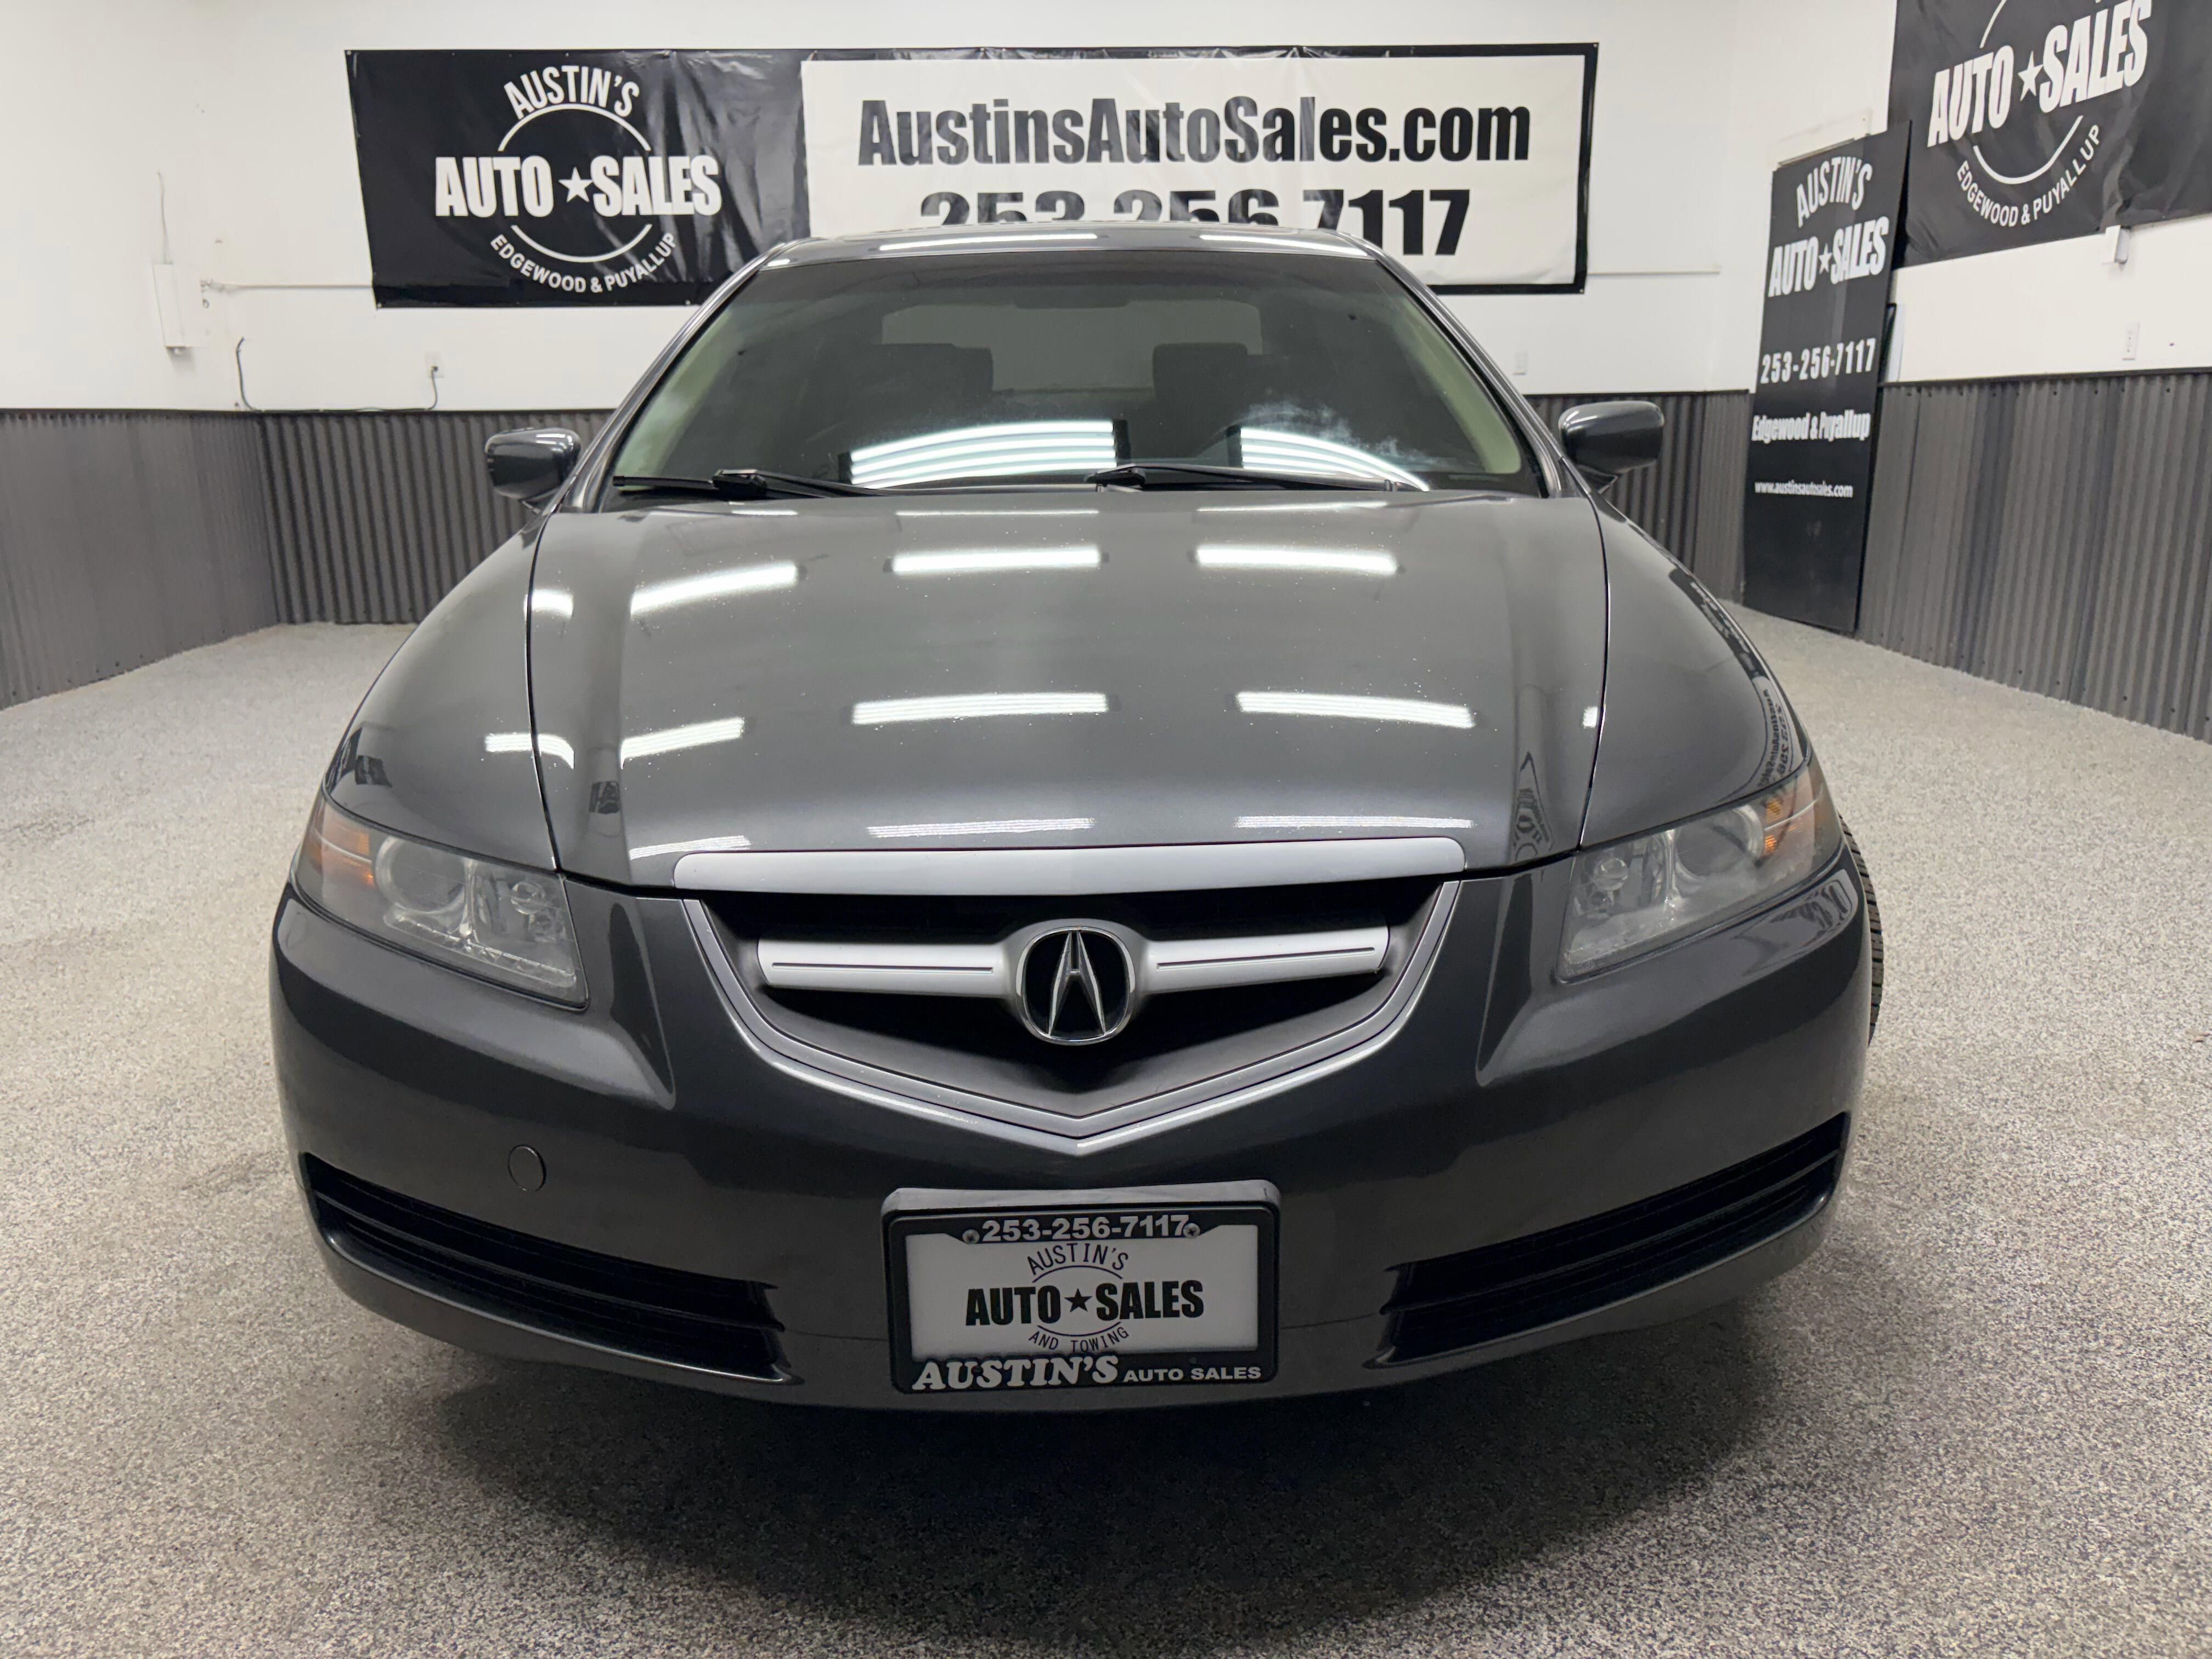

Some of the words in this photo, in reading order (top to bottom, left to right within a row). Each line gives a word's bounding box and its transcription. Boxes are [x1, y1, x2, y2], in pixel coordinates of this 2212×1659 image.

[504, 65, 640, 119] AUSTIN'S
[1927, 45, 2014, 148] AUTO
[2039, 0, 2152, 114] SALES
[858, 96, 1530, 166] AustinsAutoSales.com
[435, 155, 554, 218] AUTO
[590, 155, 722, 217] SALES
[1796, 156, 1873, 228] AUSTIN'S
[1956, 160, 2018, 228] EDGEWOOD
[2021, 205, 2030, 225] &
[2033, 125, 2101, 220] PUYALLUP
[490, 234, 586, 293] EDGEWOOD
[590, 278, 603, 294] &
[606, 233, 678, 292] PUYALLUP
[1768, 236, 1819, 298] AUTO
[1830, 216, 1889, 285] SALES
[1760, 337, 1876, 384] 253-256-7117
[1751, 412, 1810, 444] Edgewood
[1810, 416, 1819, 441] &
[1818, 409, 1871, 442] Puyallup
[981, 1214, 1189, 1242] 253-256-7117
[1027, 1243, 1128, 1276] AUSTIN'S
[965, 1285, 1061, 1326] AUTO
[1096, 1280, 1204, 1321] SALES
[1028, 1331, 1059, 1350] AND
[1071, 1327, 1130, 1353] TOWING
[912, 1355, 1119, 1390] AUSTIN'S
[1123, 1368, 1184, 1383] AUTO
[1190, 1367, 1261, 1380] SALES
